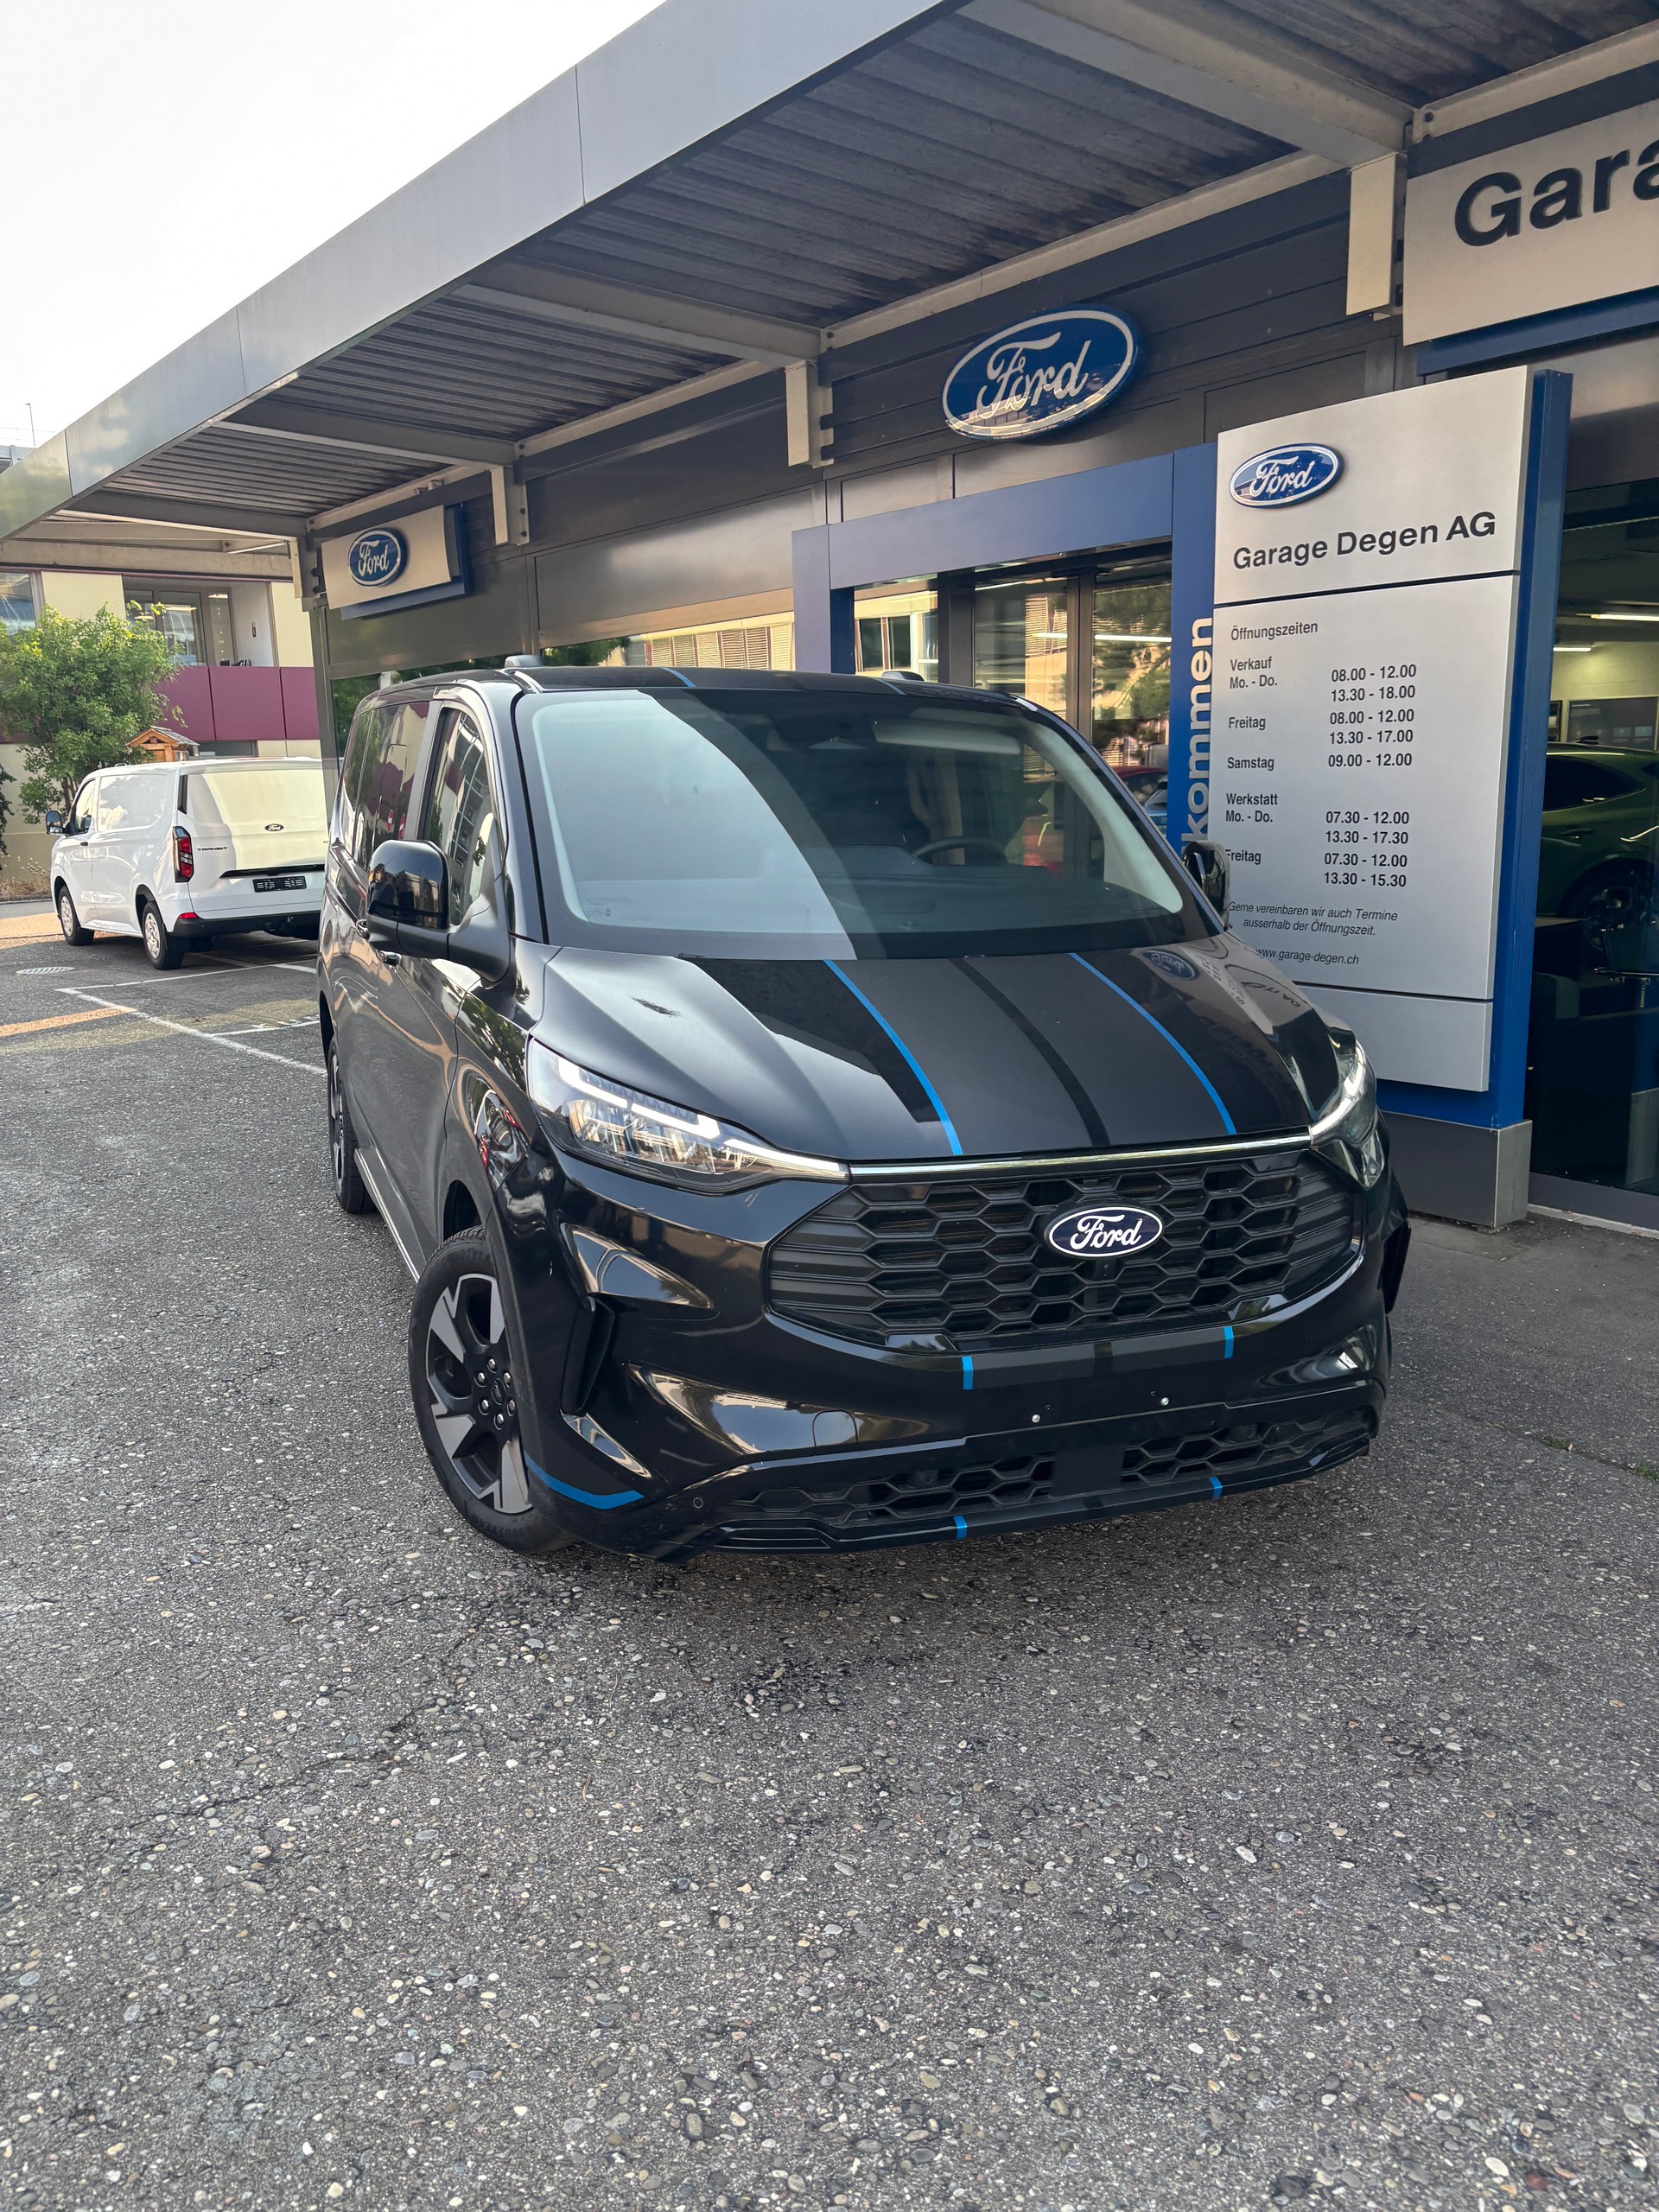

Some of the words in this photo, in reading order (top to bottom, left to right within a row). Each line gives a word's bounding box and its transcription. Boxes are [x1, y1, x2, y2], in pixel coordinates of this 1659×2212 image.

[976, 331, 1092, 419] Ford
[1249, 455, 1316, 498] Ford
[1233, 540, 1328, 569] Garage
[1337, 524, 1439, 556] Degen
[1445, 511, 1496, 541] AG
[358, 539, 390, 577] Ford
[1230, 621, 1319, 641] Öffnungszeiten
[1230, 655, 1273, 672] Verkauf
[1229, 676, 1249, 690] Mo.
[1258, 674, 1278, 688] Do.
[1331, 667, 1367, 683] 08.00
[1379, 664, 1417, 679] 12.00
[1331, 687, 1366, 702] 13.30
[1378, 684, 1416, 700] 18.00
[1228, 715, 1267, 731] Freitag
[1329, 710, 1364, 725] 08.00
[1376, 708, 1415, 723] 12.00
[1181, 617, 1213, 854] kommen
[1329, 730, 1364, 745] 13.30
[1376, 728, 1414, 743] 17.00
[1227, 756, 1275, 772] Samstag
[1327, 753, 1363, 767] 09.00
[1376, 753, 1413, 766] 12.00
[1225, 792, 1279, 806] Werkstatt
[1225, 810, 1244, 823] Mo.
[1254, 810, 1274, 823] Do.
[1325, 810, 1361, 824] 07.30
[1372, 810, 1410, 825] 12.00
[1325, 830, 1360, 844] 13.30
[1372, 830, 1409, 845] 17.30
[1324, 852, 1359, 867] 07.30
[1370, 853, 1408, 868] 12.00
[1324, 871, 1358, 886] 13.30
[1370, 873, 1407, 887] 15.30
[1229, 901, 1254, 913] Gerne
[1255, 904, 1309, 917] vereinbaren
[1311, 906, 1325, 918] wir
[1326, 907, 1353, 919] auch
[1355, 908, 1399, 922] Termine
[1243, 917, 1291, 931] ausserhalb
[1293, 920, 1309, 931] der
[1310, 918, 1376, 937] Öffnungszeit.
[1255, 948, 1359, 965] www.garage-degen.ch
[1070, 1214, 1143, 1250] Ford
